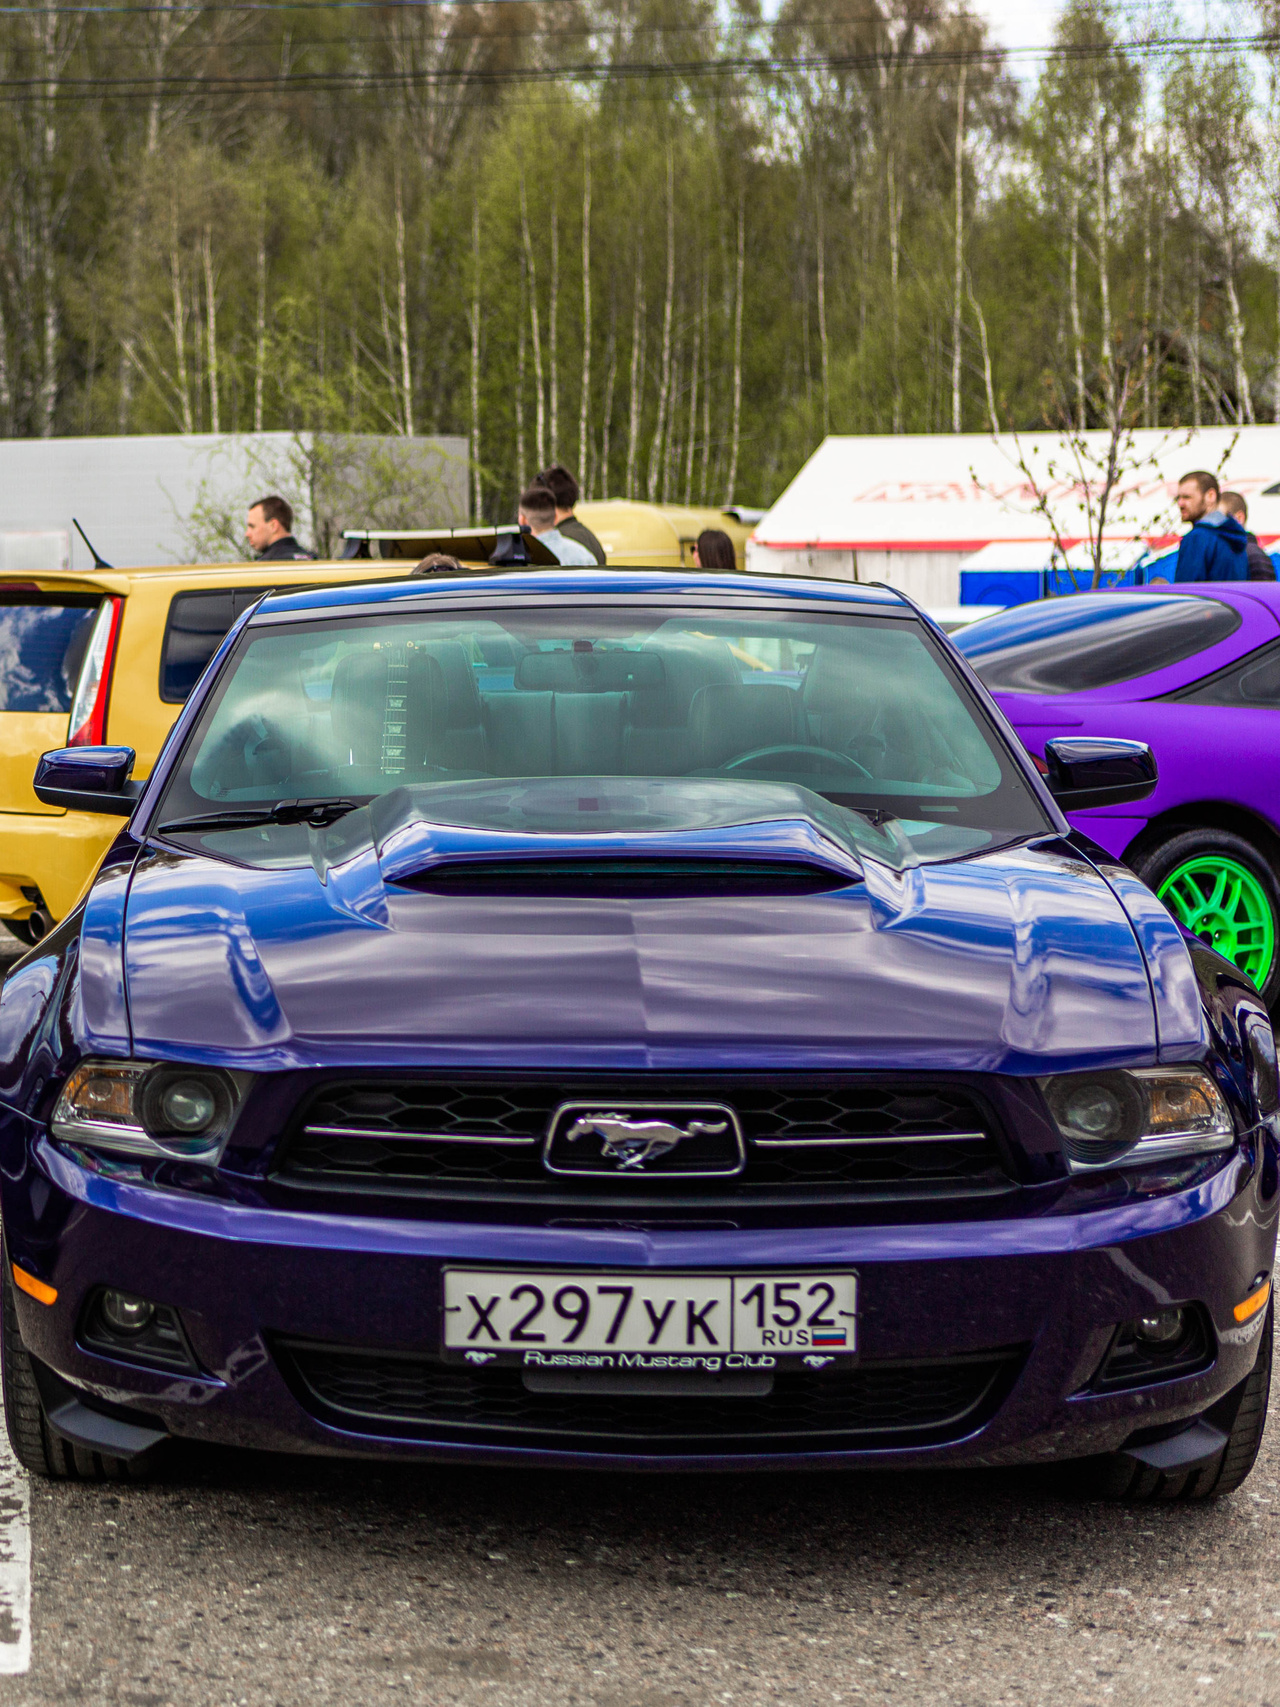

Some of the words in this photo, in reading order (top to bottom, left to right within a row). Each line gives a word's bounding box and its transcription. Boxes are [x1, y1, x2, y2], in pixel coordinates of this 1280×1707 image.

[740, 1282, 836, 1328] 152
[762, 1329, 809, 1345] RUS
[523, 1351, 613, 1367] Russian
[617, 1352, 721, 1370] Mustang
[724, 1352, 776, 1368] Club
